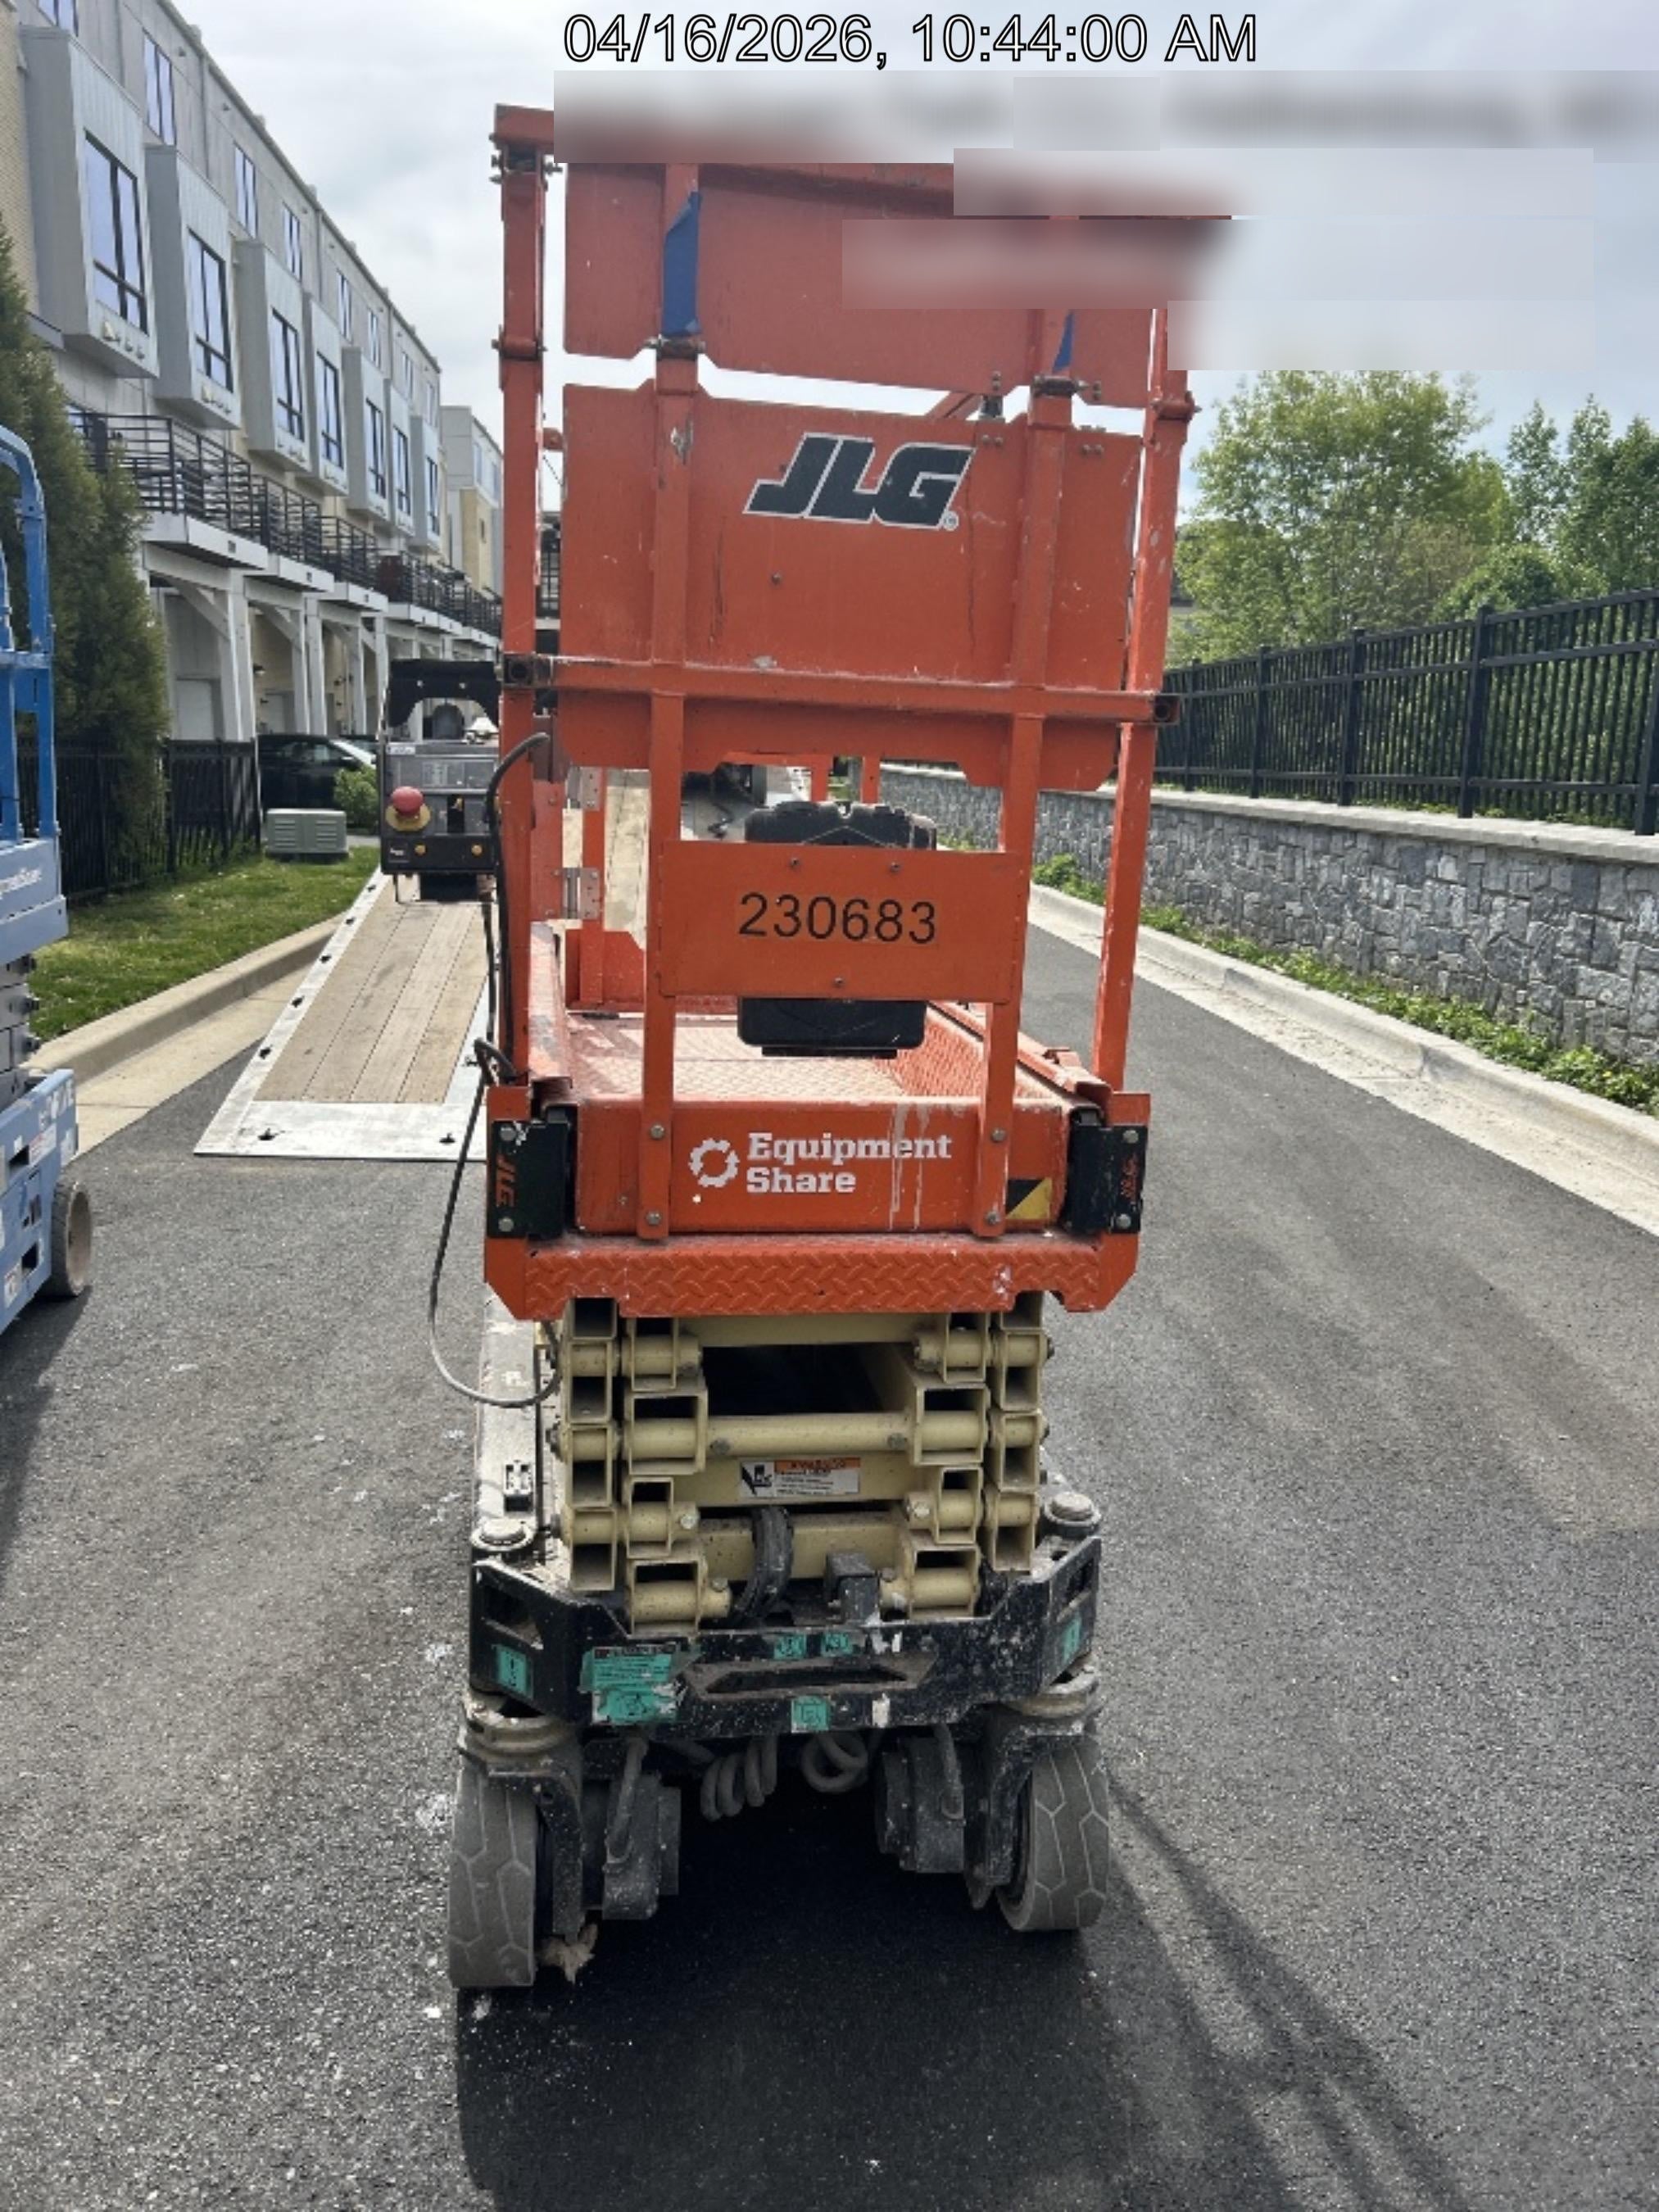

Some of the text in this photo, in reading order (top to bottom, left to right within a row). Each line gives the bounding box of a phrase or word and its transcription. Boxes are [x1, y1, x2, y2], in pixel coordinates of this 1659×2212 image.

[742, 432, 977, 529] JLG
[738, 892, 936, 944] 230683
[746, 1132, 953, 1166] Equipment
[746, 1167, 856, 1193] Share
